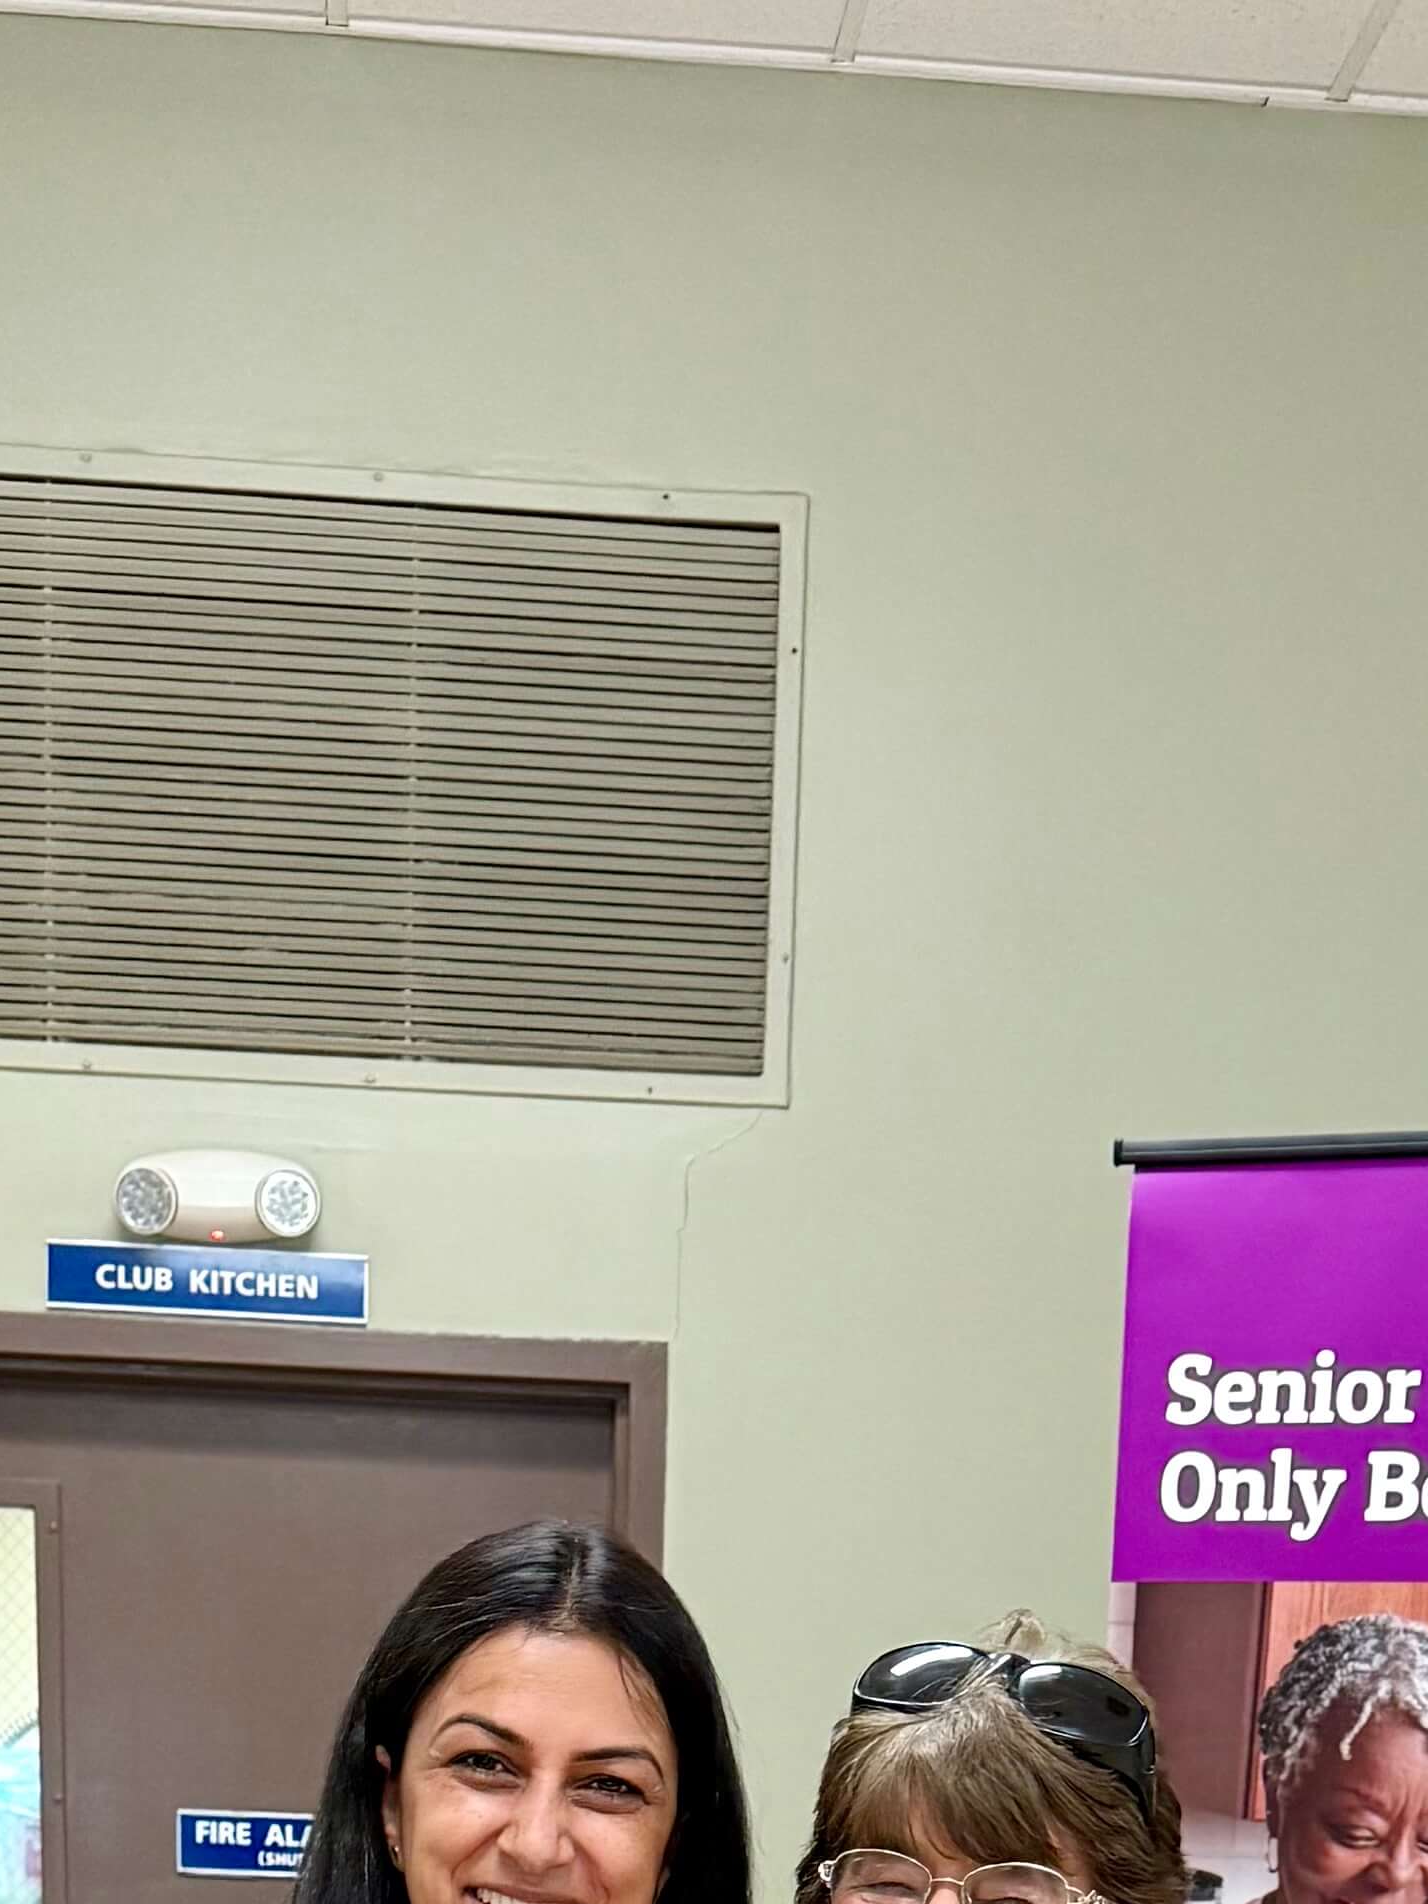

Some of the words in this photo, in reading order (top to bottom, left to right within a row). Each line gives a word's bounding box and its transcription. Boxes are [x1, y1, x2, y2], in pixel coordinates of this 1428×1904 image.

[95, 1264, 173, 1293] CLUB
[189, 1269, 319, 1300] KITCHEN
[1165, 1349, 1424, 1426] Senior
[1158, 1447, 1347, 1542] Only
[195, 1820, 252, 1847] FIRE
